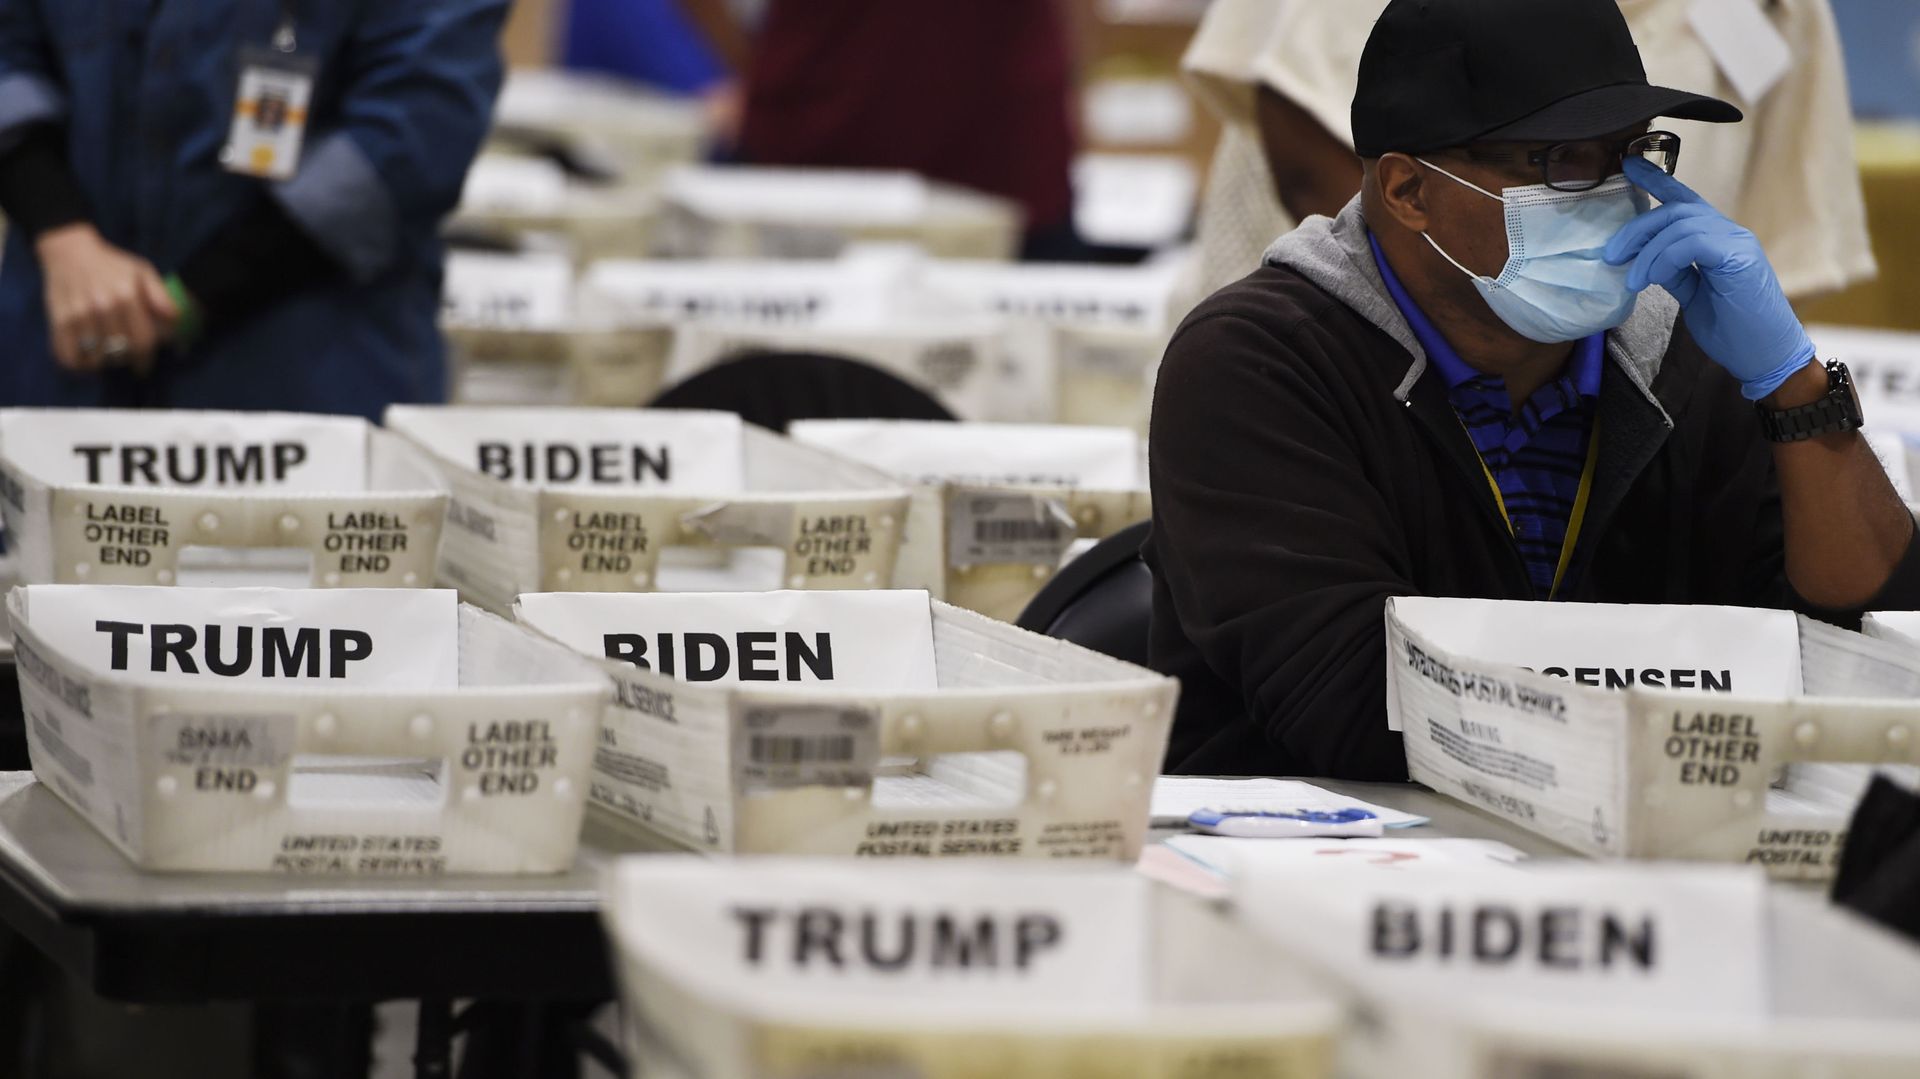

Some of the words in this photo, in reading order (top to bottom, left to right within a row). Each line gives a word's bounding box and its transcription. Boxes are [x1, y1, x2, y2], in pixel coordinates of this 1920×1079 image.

[73, 443, 308, 484] TRUMP
[477, 443, 670, 482] BIDEN
[86, 503, 169, 527] LABEL
[328, 512, 408, 531] LABEL
[573, 512, 647, 533] LABEL
[801, 514, 871, 535] LABEL
[85, 525, 169, 547] OTHER
[324, 533, 408, 552] OTHER
[567, 533, 649, 555] OTHER
[794, 535, 872, 555] OTHER
[100, 548, 151, 568] END
[340, 555, 390, 573] END
[581, 555, 632, 574] END
[807, 555, 855, 576] END
[95, 620, 373, 679] TRUMP
[604, 631, 834, 682] BIDEN
[468, 720, 555, 745] LABEL
[1672, 711, 1760, 738] LABEL
[461, 745, 558, 771] OTHER
[1664, 736, 1763, 764] OTHER
[194, 768, 258, 793] END
[478, 771, 539, 796] END
[1679, 762, 1741, 787] END
[866, 820, 939, 838] UNITED
[942, 818, 1021, 835] STATES
[1758, 829, 1832, 846] UNITED
[281, 836, 358, 852] UNITED
[361, 836, 443, 851] STATES
[855, 841, 932, 858] POSTAL
[939, 838, 1024, 857] SERVICE
[1745, 848, 1823, 866] POSTAL
[732, 905, 1064, 973] TRUMP
[1369, 904, 1660, 971] BIDEN
